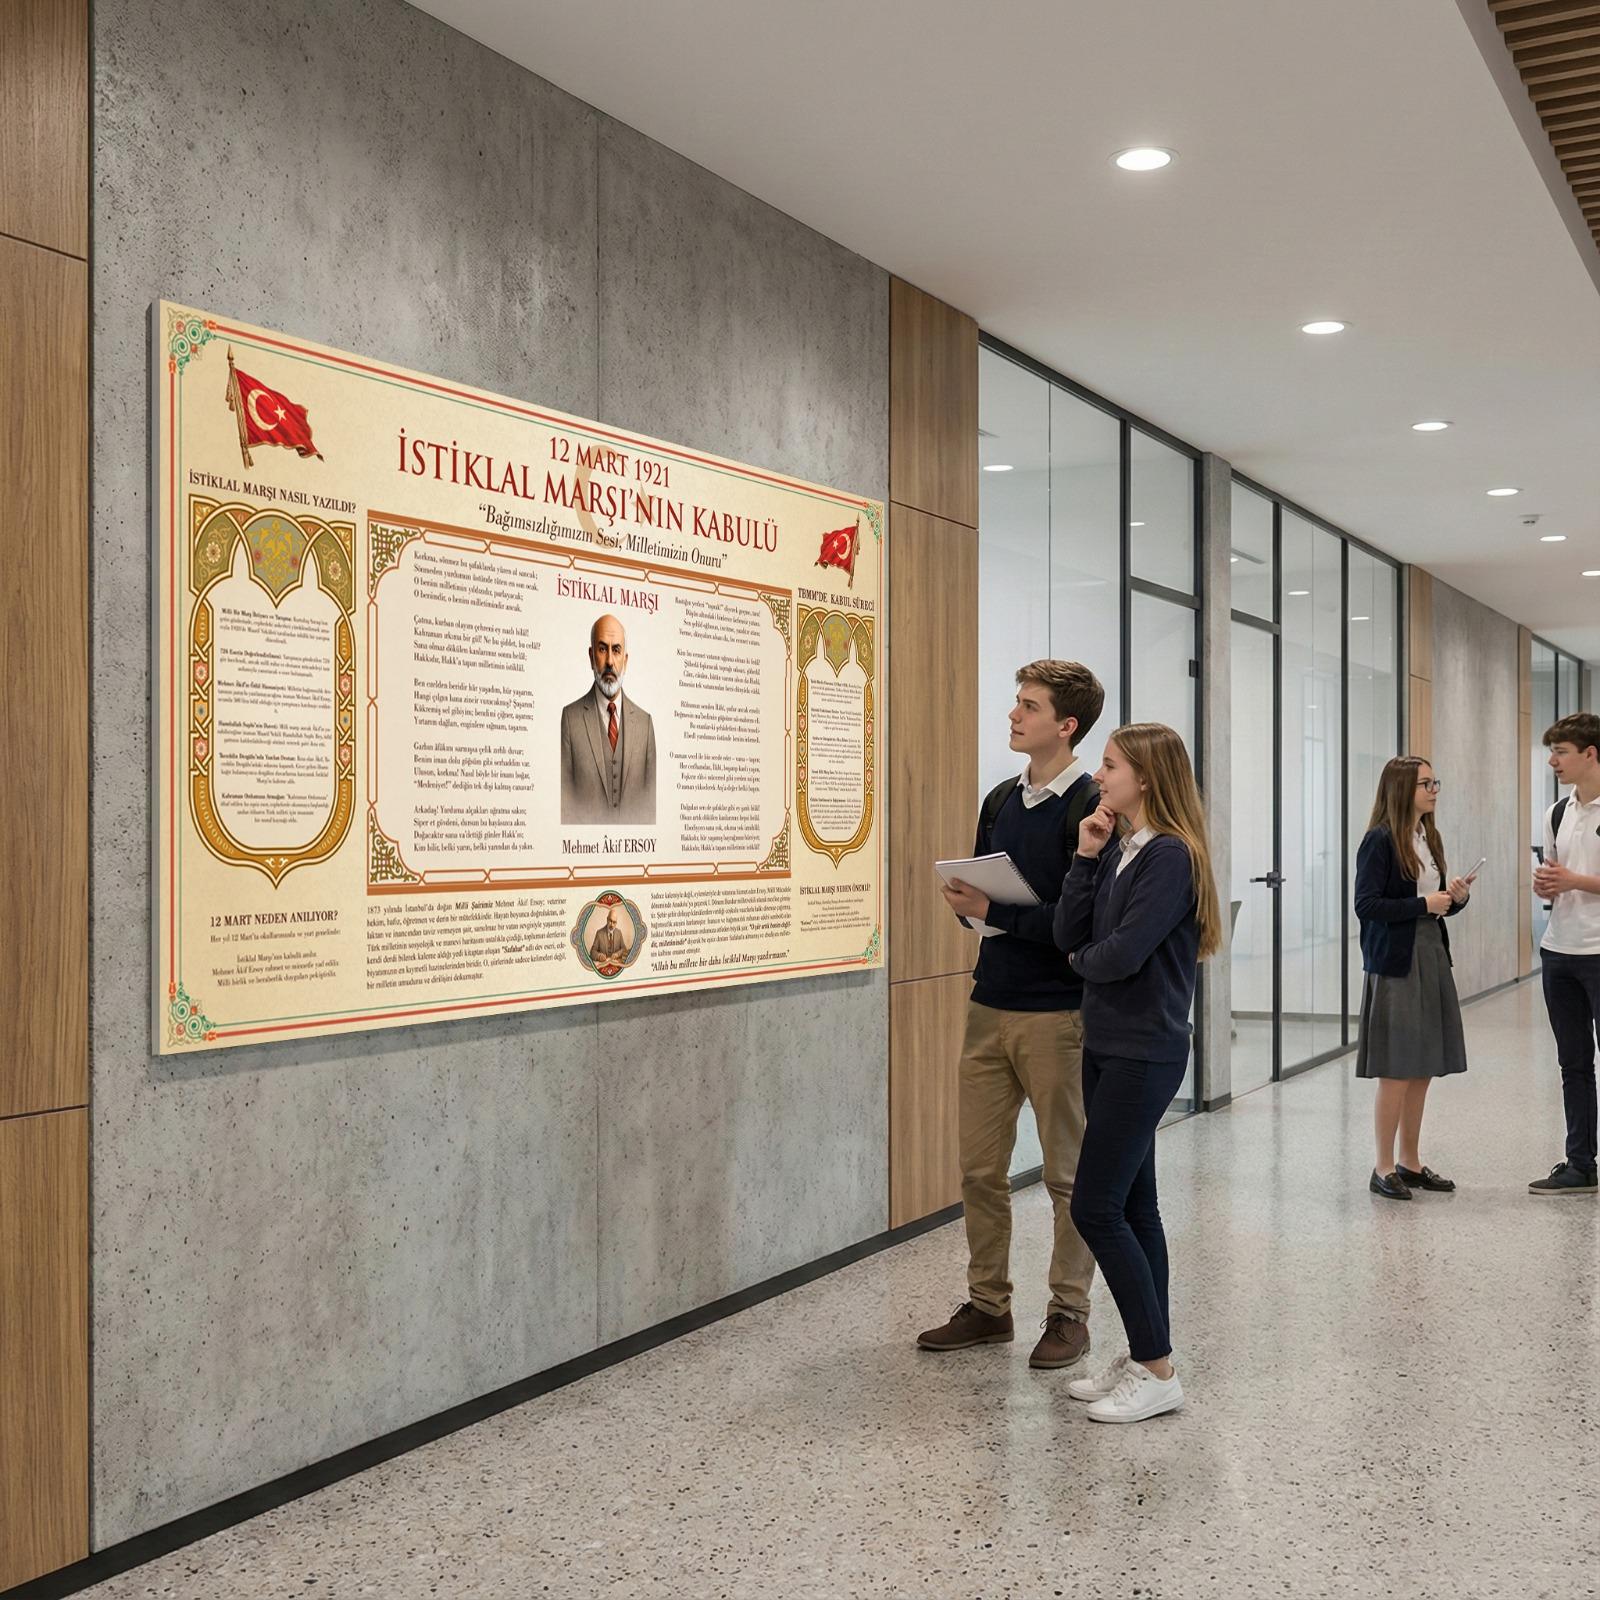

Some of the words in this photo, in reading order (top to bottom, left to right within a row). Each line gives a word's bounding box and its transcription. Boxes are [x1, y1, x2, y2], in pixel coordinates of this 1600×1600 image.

[550, 437, 569, 463] 12
[575, 442, 629, 477] MART
[635, 459, 670, 487] 1921
[189, 469, 240, 492] İSTİKLAL
[243, 481, 276, 501] MARŞI
[279, 488, 310, 505] NASIL
[312, 495, 356, 513] YAZILDI?
[399, 429, 534, 499] İSTİKLAL
[544, 470, 684, 532] MARŞI’NIN
[692, 506, 778, 553] KABULÜ
[595, 526, 622, 552] Sesi,
[624, 533, 687, 561] Milletimizin
[557, 574, 616, 603] İSTİKLAL
[620, 588, 658, 614] MARŞI
[830, 593, 851, 607] KABUL
[562, 839, 598, 854] Mehmet
[602, 834, 622, 853] Âkif
[624, 838, 656, 853] ERSOY
[210, 916, 221, 927] 12
[224, 914, 252, 926] MART
[254, 912, 287, 924] NEDEN
[290, 910, 338, 922] ANILIYOR?
